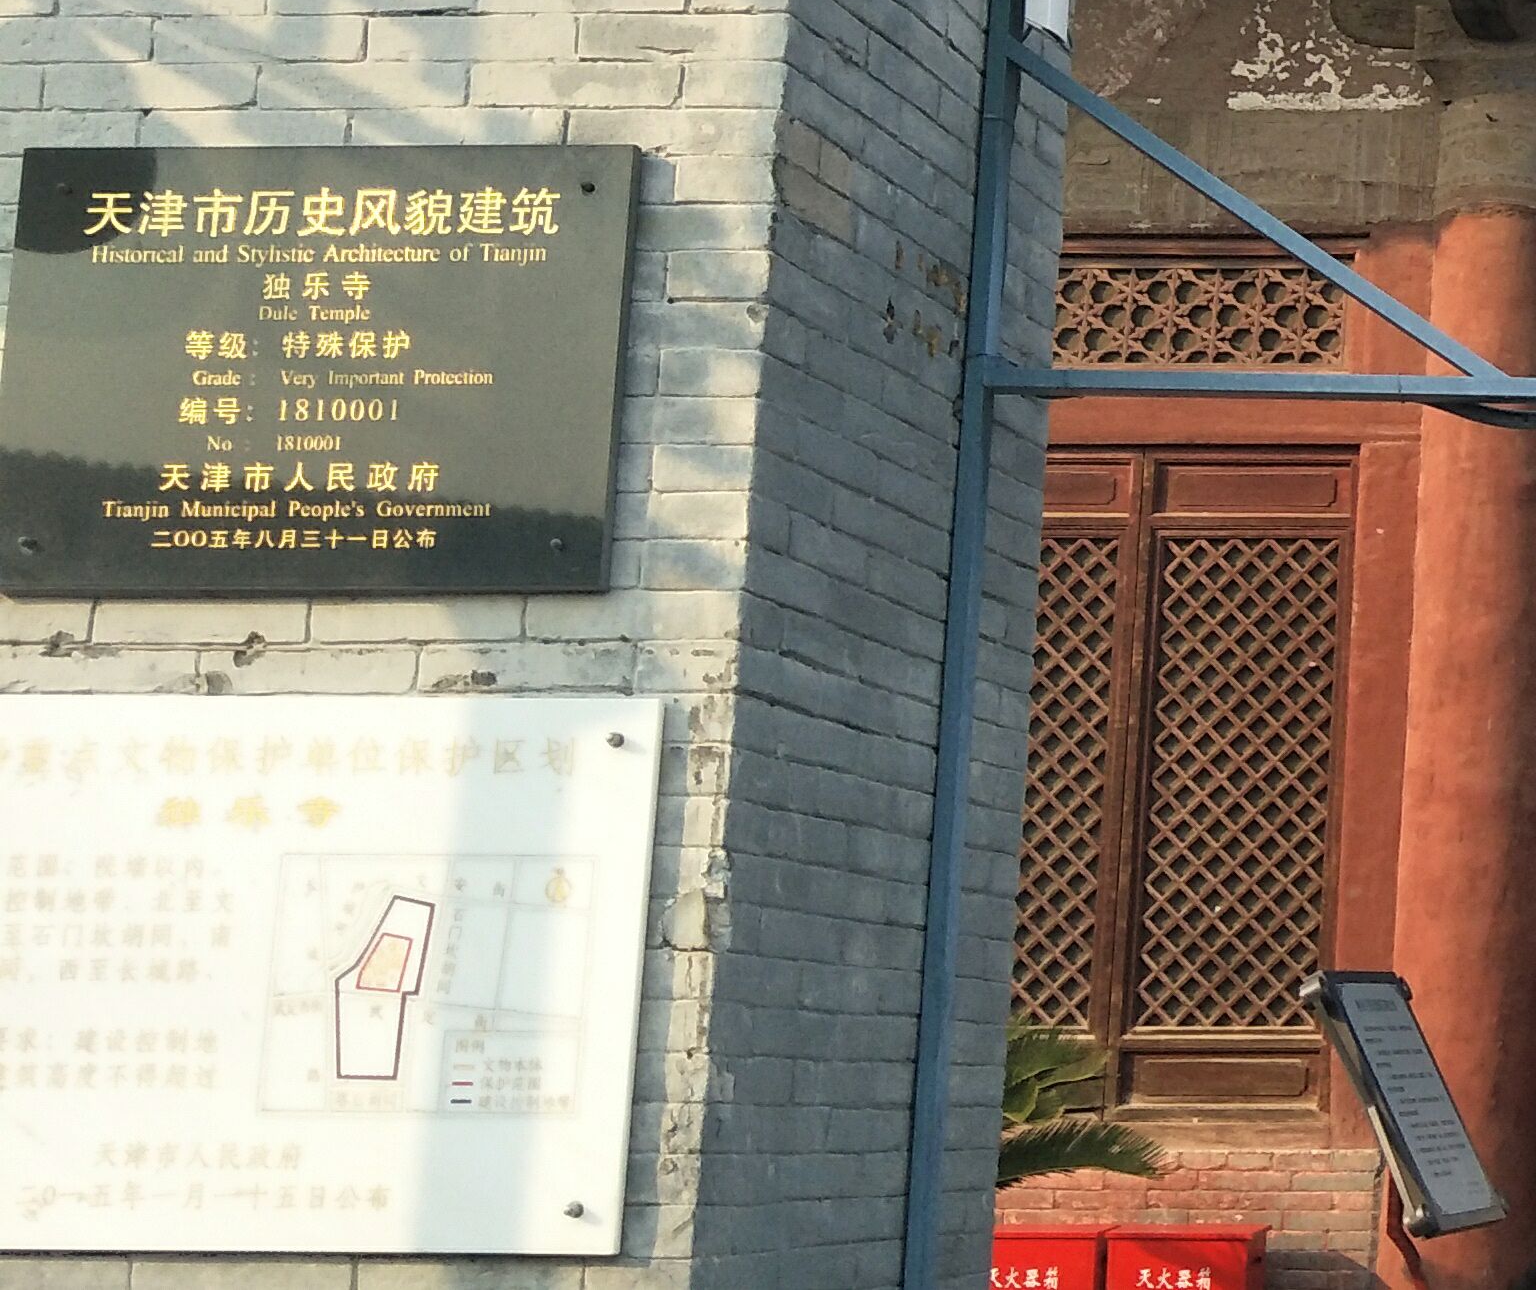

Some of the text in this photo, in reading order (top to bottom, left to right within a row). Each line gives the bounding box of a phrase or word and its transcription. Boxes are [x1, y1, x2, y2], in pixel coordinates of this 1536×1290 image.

[82, 187, 561, 238] 天津市历史风貌建筑
[91, 242, 548, 268] Historical and Stylistic Architecture of Tianjin
[262, 271, 372, 301] 独乐寺
[258, 304, 371, 325] Dule Temple
[281, 329, 412, 360] 特殊保护
[280, 370, 318, 388] Very
[328, 370, 405, 389] Important
[413, 369, 494, 386] Protection
[277, 398, 399, 423] 1810001
[275, 435, 342, 452] 1810001
[159, 461, 441, 494] 天津市人民政府
[101, 499, 493, 521] Tianjin Municipal People's Government
